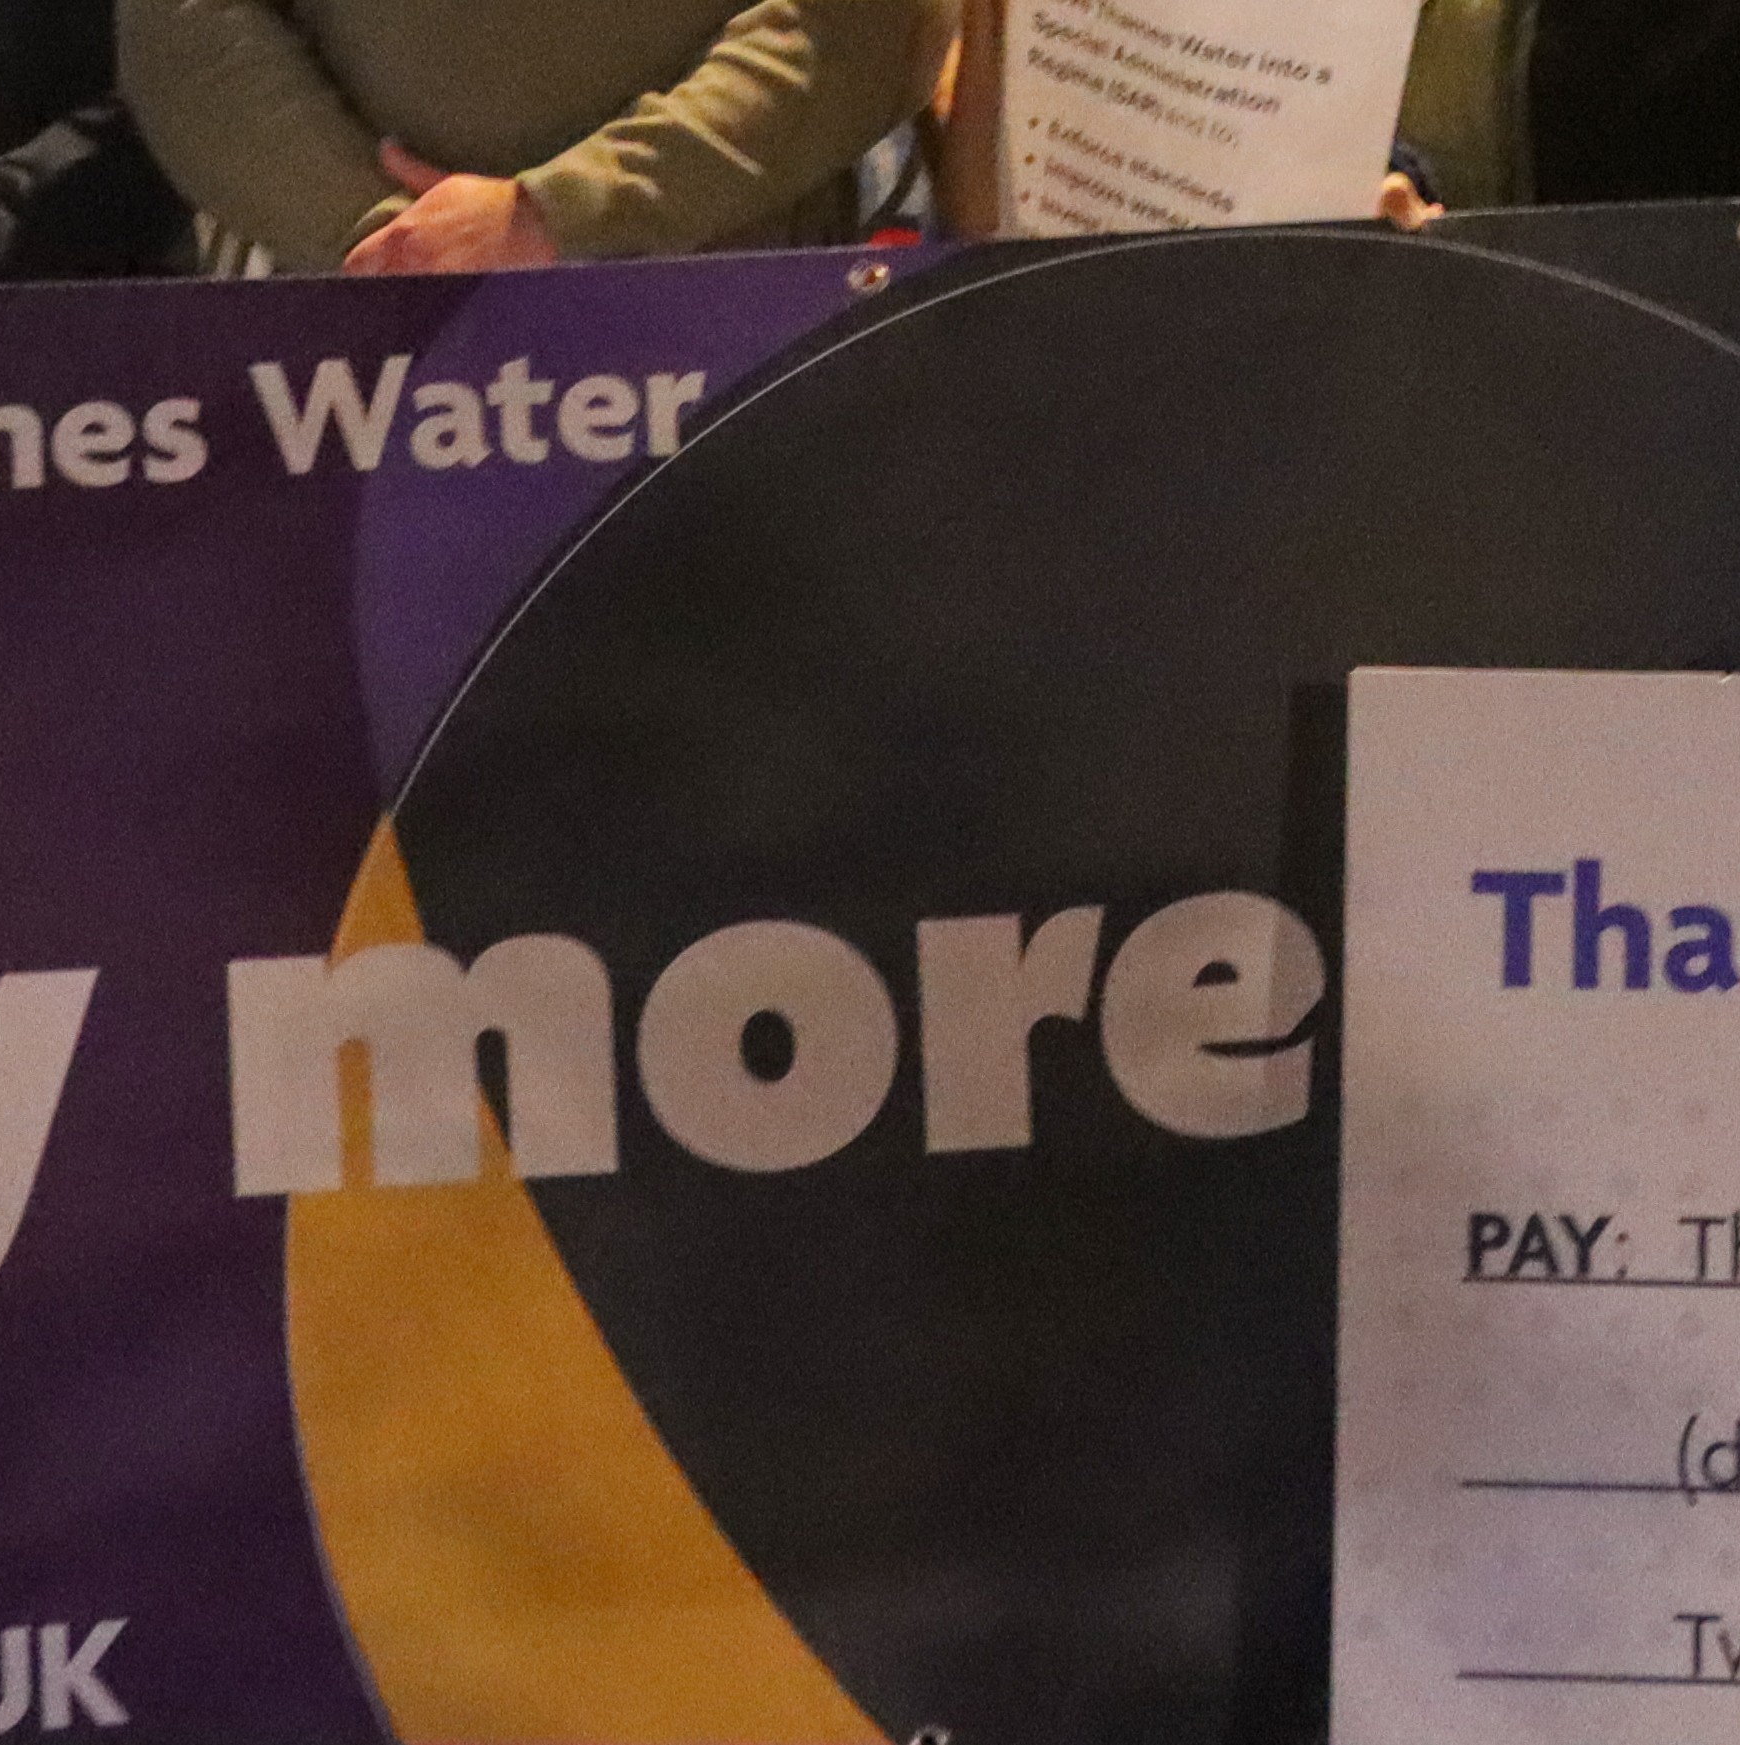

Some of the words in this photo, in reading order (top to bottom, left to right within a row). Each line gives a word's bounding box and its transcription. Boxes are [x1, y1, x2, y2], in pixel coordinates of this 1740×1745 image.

[1178, 34, 1253, 69] Water
[1257, 52, 1310, 80] into
[1316, 67, 1331, 84] a
[250, 353, 707, 478] Water
[226, 890, 1326, 1198] more
[1466, 1214, 1632, 1281] PAY:
